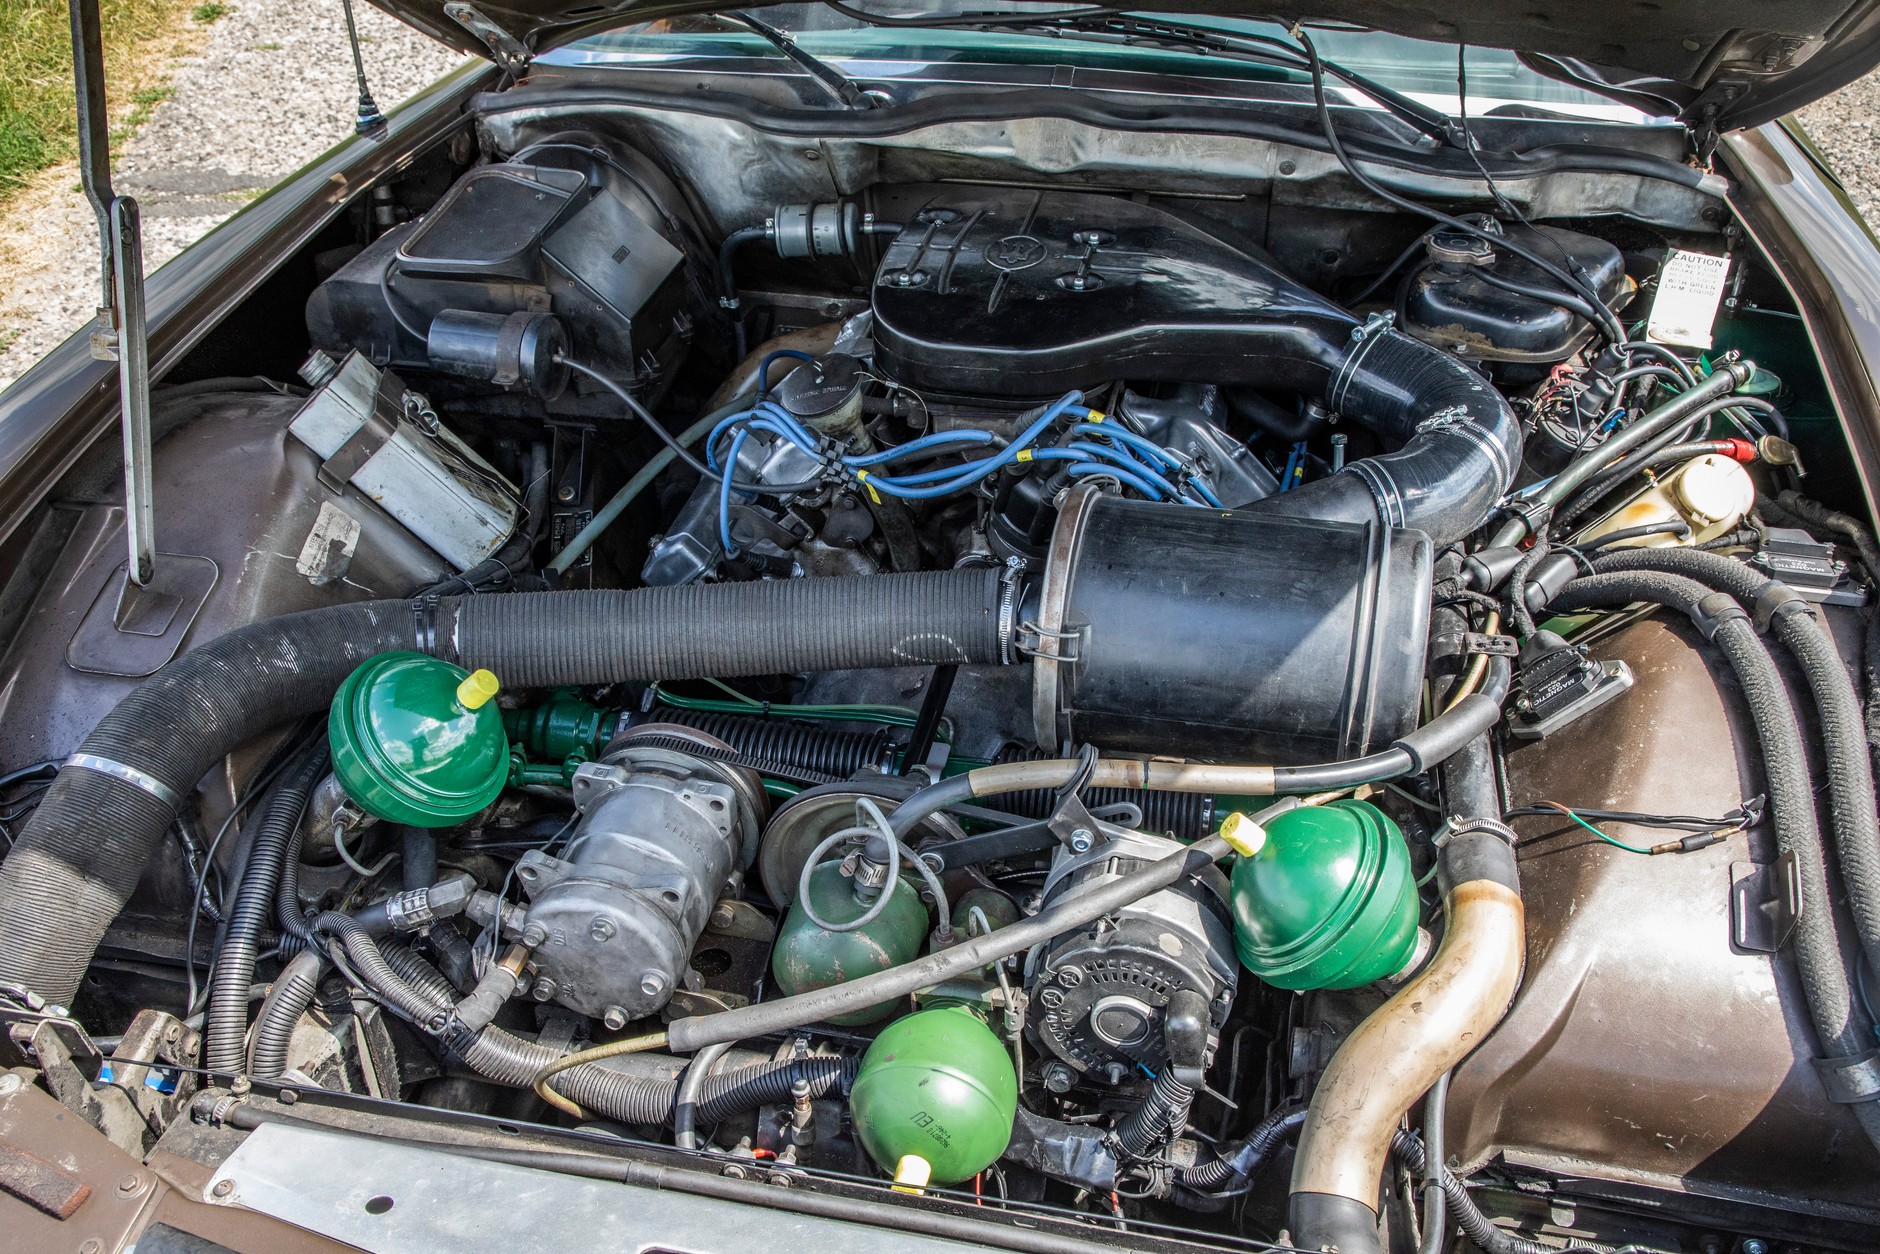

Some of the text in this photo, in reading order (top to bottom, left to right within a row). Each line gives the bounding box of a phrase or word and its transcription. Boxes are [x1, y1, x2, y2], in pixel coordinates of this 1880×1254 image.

[1672, 252, 1724, 267] CAUTION
[1669, 266, 1693, 274] BRAKE
[1667, 278, 1717, 290] WITH GREEN
[1689, 288, 1715, 297] LIQUID
[1774, 562, 1826, 572] MAGNETIC
[1533, 678, 1576, 706] MAGNETIC
[1547, 682, 1561, 693] 023
[909, 1111, 934, 1128] EU
